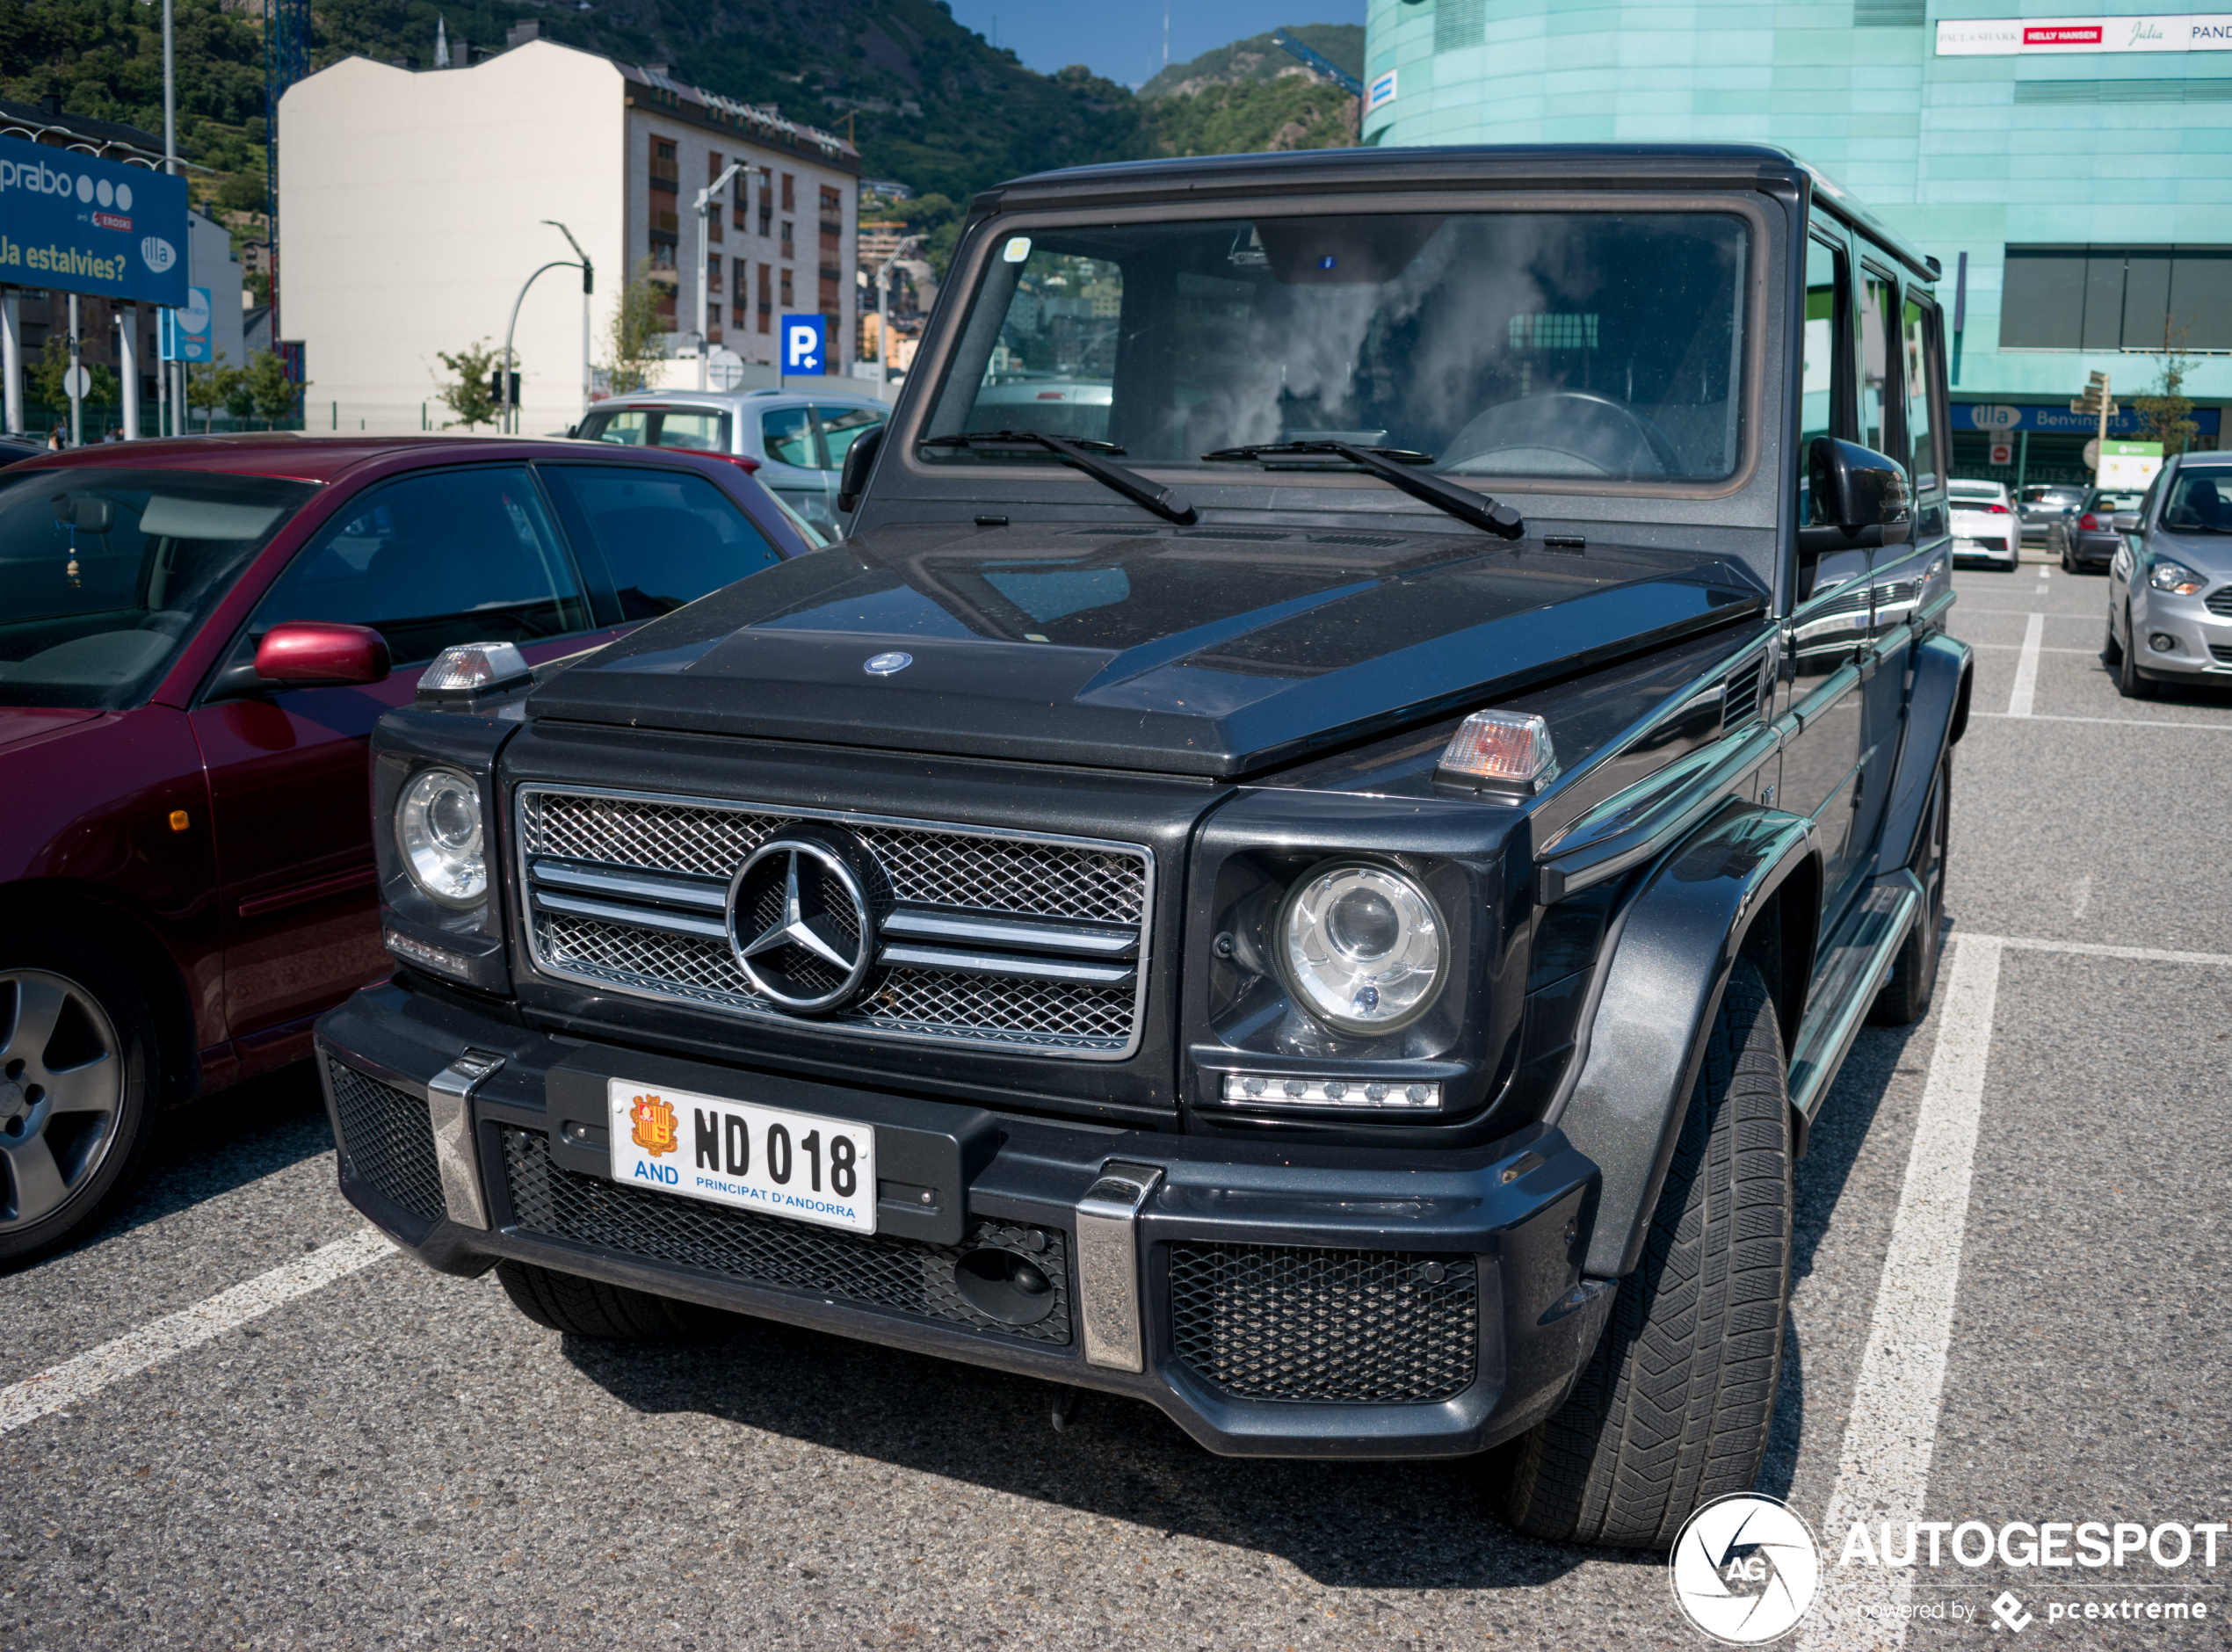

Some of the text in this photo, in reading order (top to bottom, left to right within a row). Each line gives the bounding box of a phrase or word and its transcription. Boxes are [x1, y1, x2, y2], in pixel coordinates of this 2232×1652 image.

[1977, 32, 2018, 41] SHARK
[2027, 31, 2098, 40] HELLY HANSEN
[103, 216, 131, 230] EROSKI
[0, 235, 126, 281] Ja estalvies?
[145, 237, 168, 263] illa
[790, 326, 818, 366] P
[1976, 404, 2009, 424] illa
[2036, 409, 2129, 431] Benvinguts
[694, 1107, 857, 1198] ND 018
[634, 1160, 679, 1185] AND
[696, 1177, 856, 1219] PRINCIPAT D'ANDORRA
